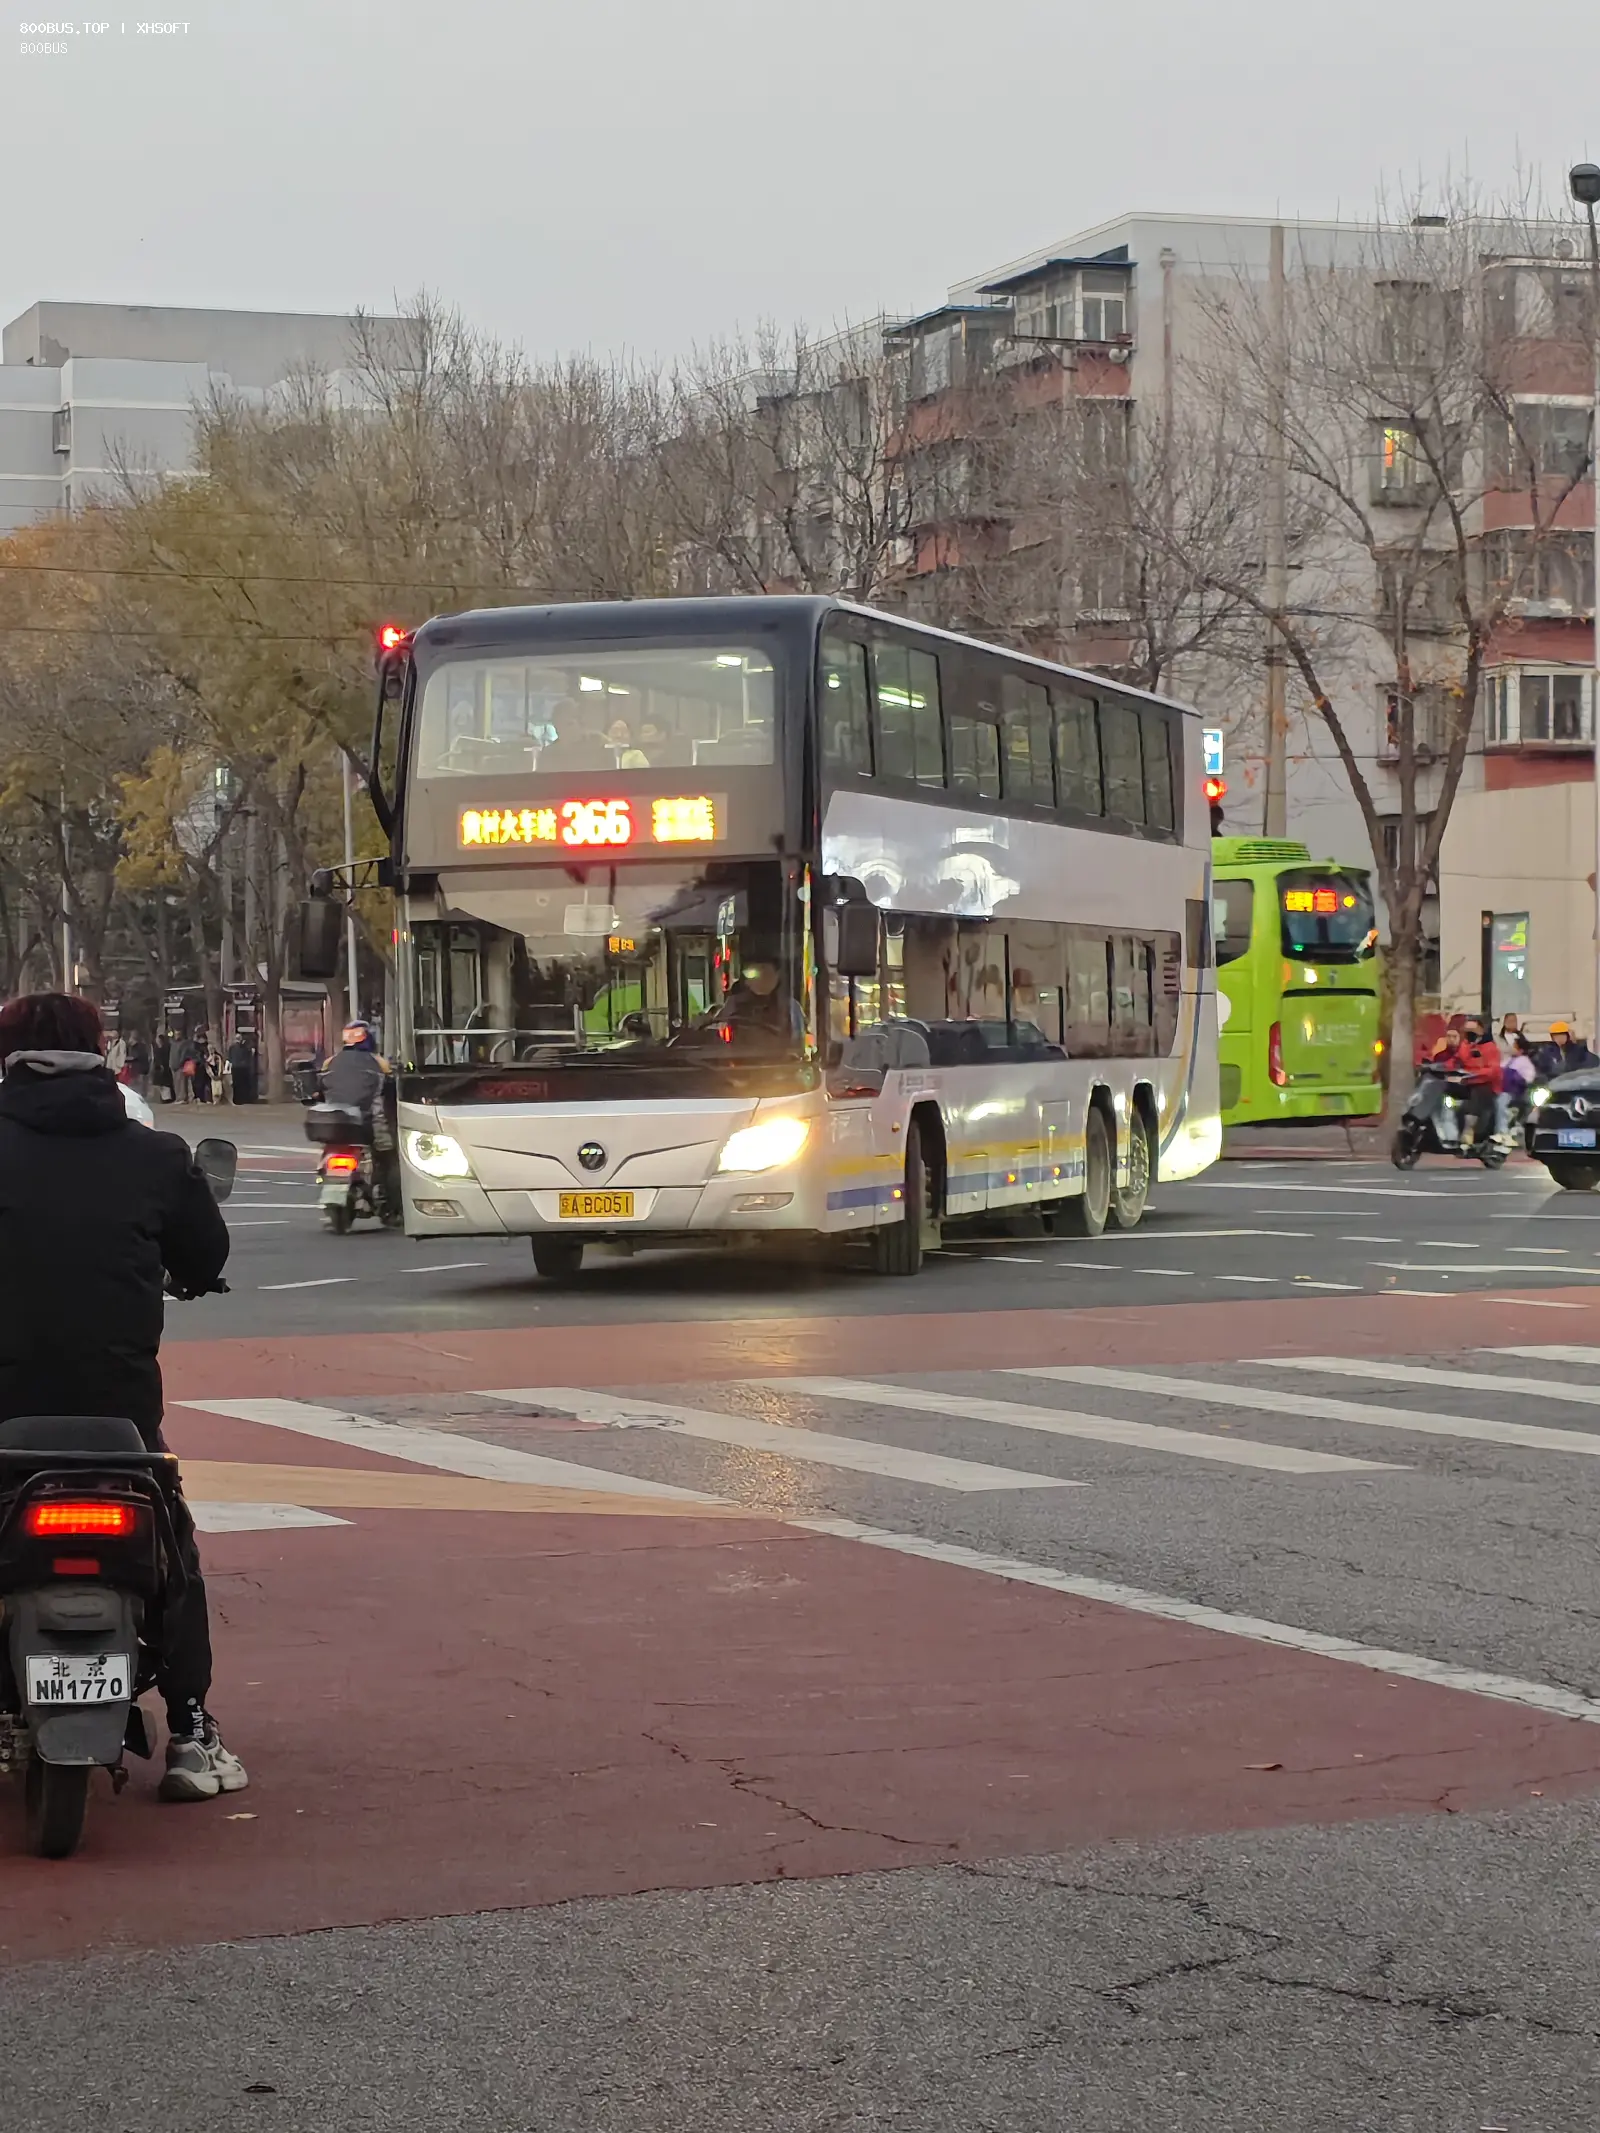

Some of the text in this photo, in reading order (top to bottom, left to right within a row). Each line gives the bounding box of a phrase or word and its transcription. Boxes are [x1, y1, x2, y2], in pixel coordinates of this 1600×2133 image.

[561, 800, 631, 845] 366
[50, 1660, 105, 1678] 北京
[36, 1677, 123, 1700] NM1770
